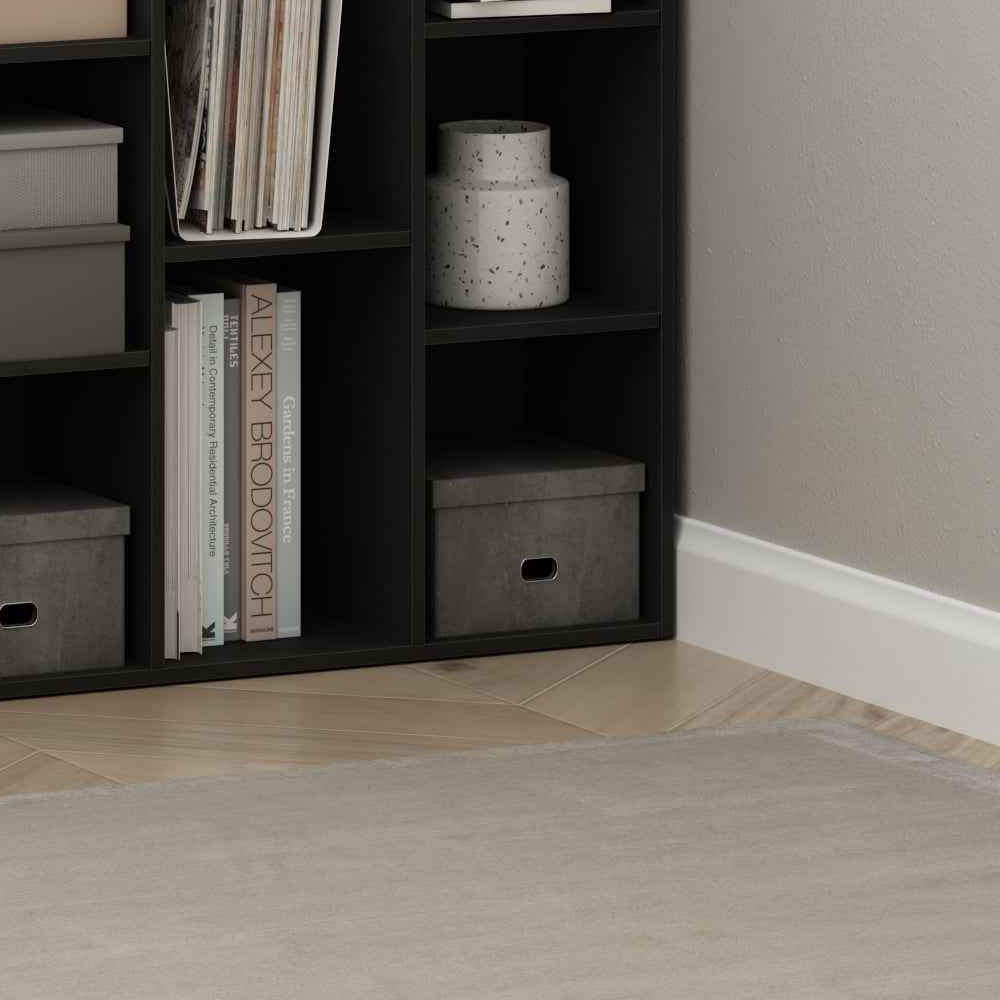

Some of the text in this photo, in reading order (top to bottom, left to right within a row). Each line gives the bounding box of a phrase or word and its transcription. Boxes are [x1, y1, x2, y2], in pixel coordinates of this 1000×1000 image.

[230, 314, 239, 368] TEXTILES
[206, 325, 218, 558] Detail in Contemporary Residential Architecture
[250, 294, 273, 617] ALEXEY BRODOVITCH
[282, 396, 296, 544] Gardens in France
